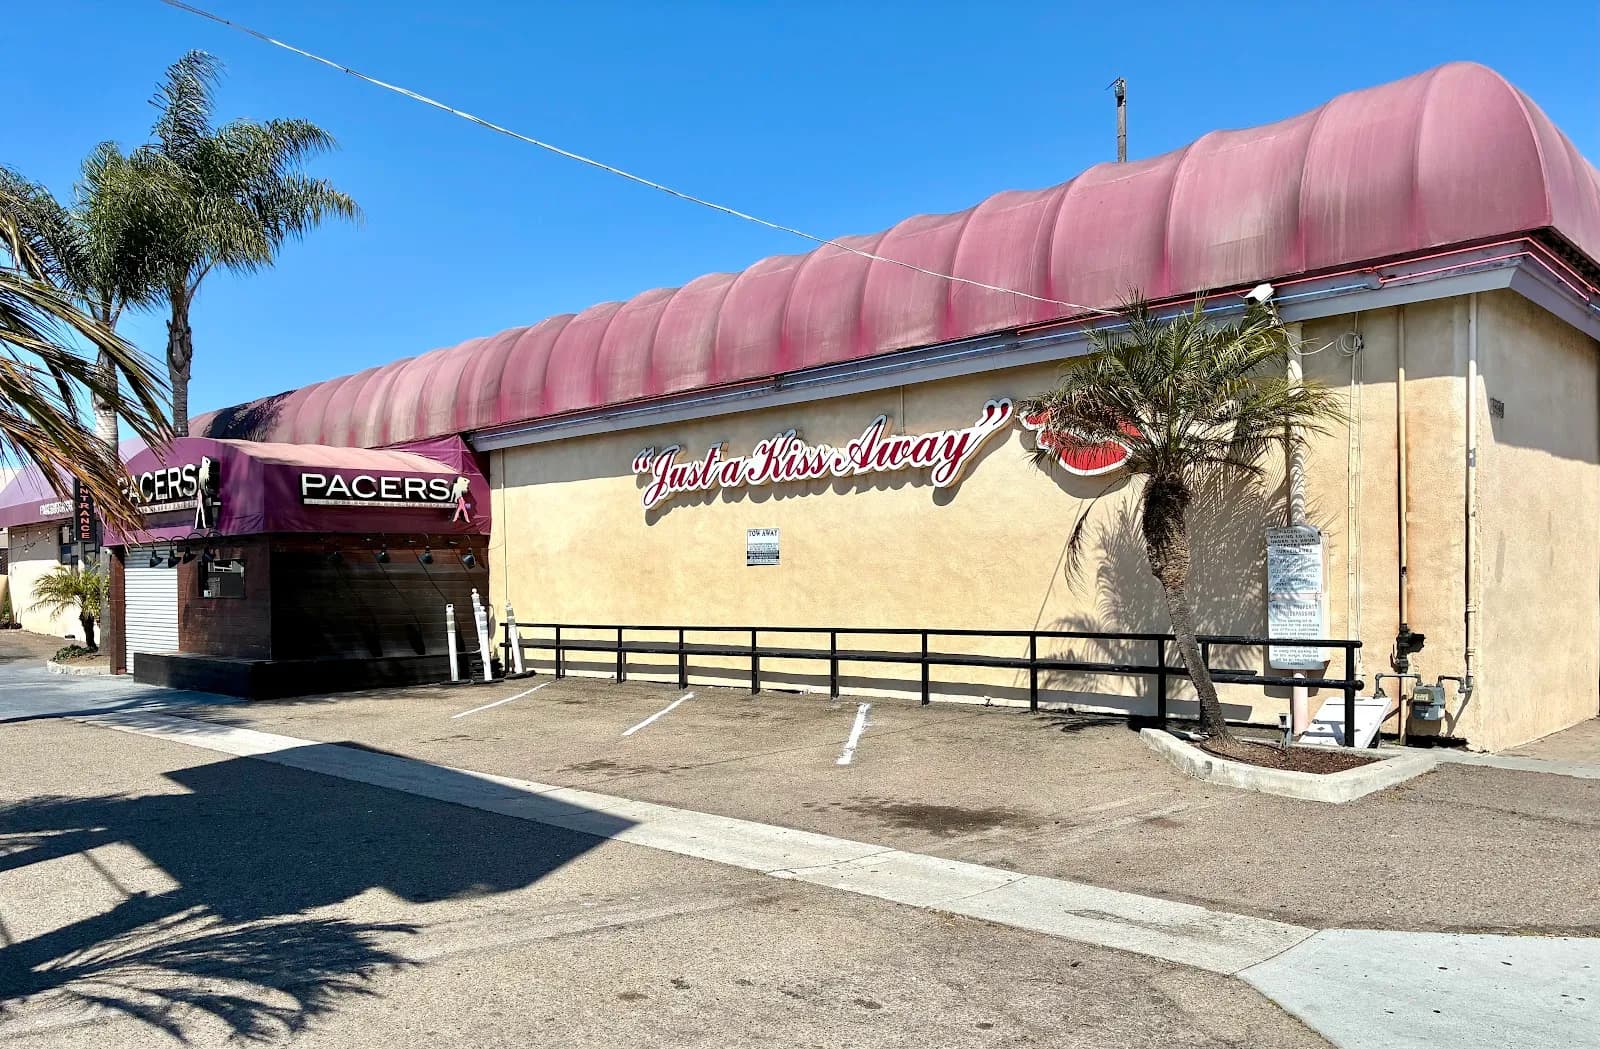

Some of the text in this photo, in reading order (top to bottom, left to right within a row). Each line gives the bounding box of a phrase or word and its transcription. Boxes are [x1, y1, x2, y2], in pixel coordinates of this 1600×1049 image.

[720, 457, 747, 485] a
[748, 431, 833, 482] Kiss
[80, 481, 91, 540] NTRANCE
[301, 472, 450, 501] PACERS
